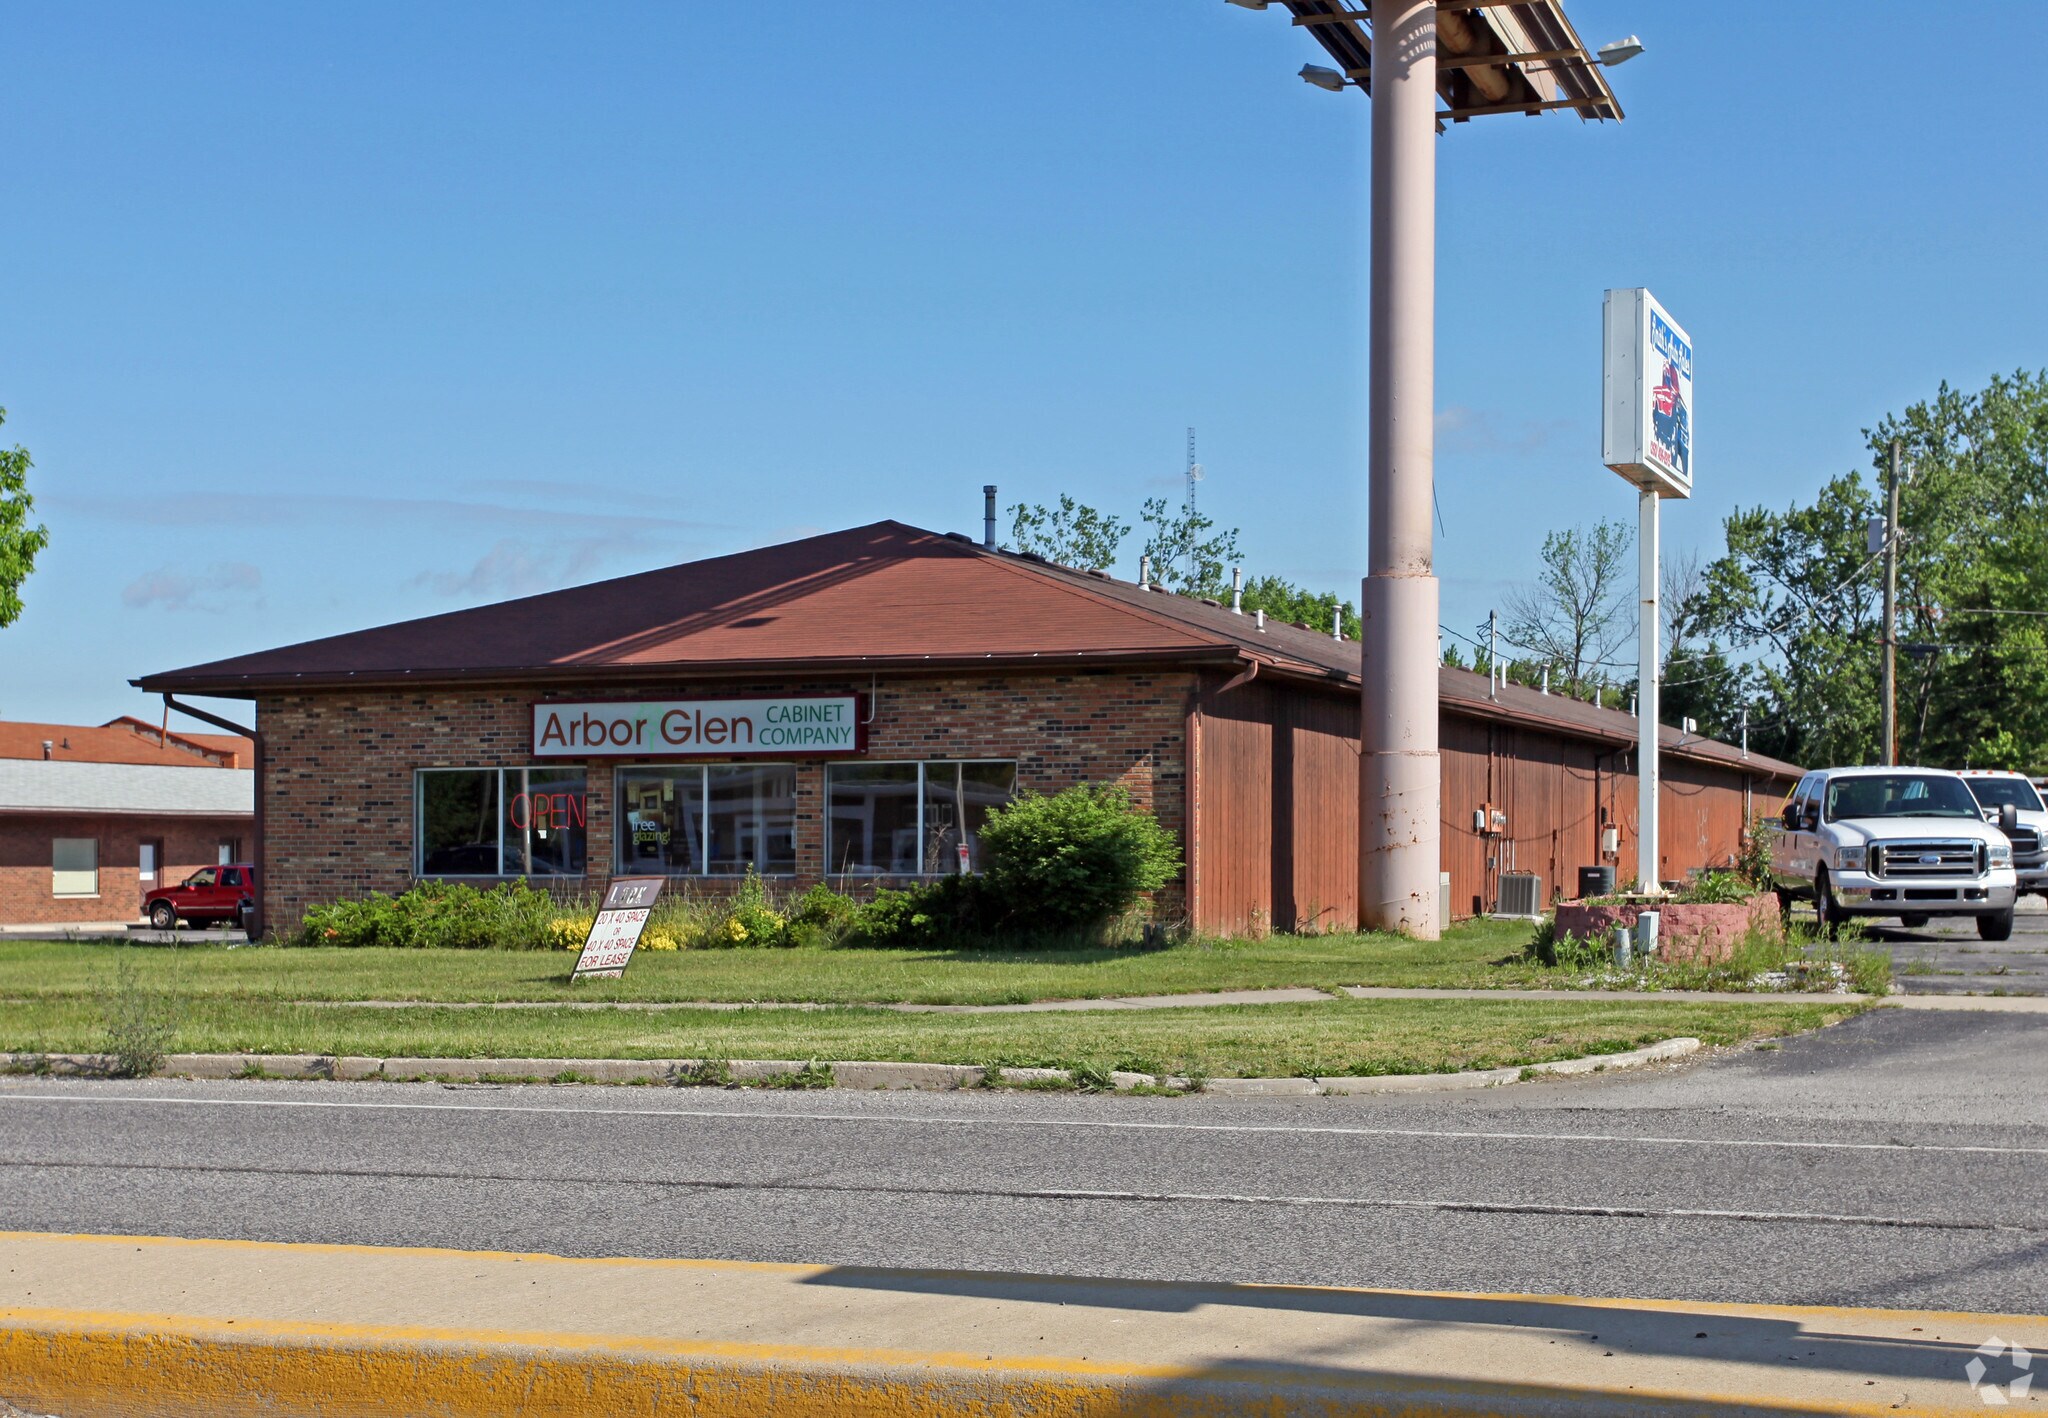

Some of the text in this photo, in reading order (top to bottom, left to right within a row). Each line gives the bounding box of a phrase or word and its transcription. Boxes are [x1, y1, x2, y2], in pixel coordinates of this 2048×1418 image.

[766, 704, 845, 723] CABINET
[539, 709, 753, 747] Arbor Glen
[759, 726, 852, 746] COMPANY
[511, 793, 586, 829] OPEN
[632, 818, 656, 831] free
[632, 828, 671, 845] glazing!
[598, 912, 607, 925] 20
[615, 911, 625, 923] 40
[625, 910, 647, 923] SPACE
[613, 927, 621, 936] OR
[587, 940, 597, 952] 40
[604, 938, 614, 951] 40
[614, 937, 635, 950] SPACE
[579, 952, 629, 968] FOR LEASE
